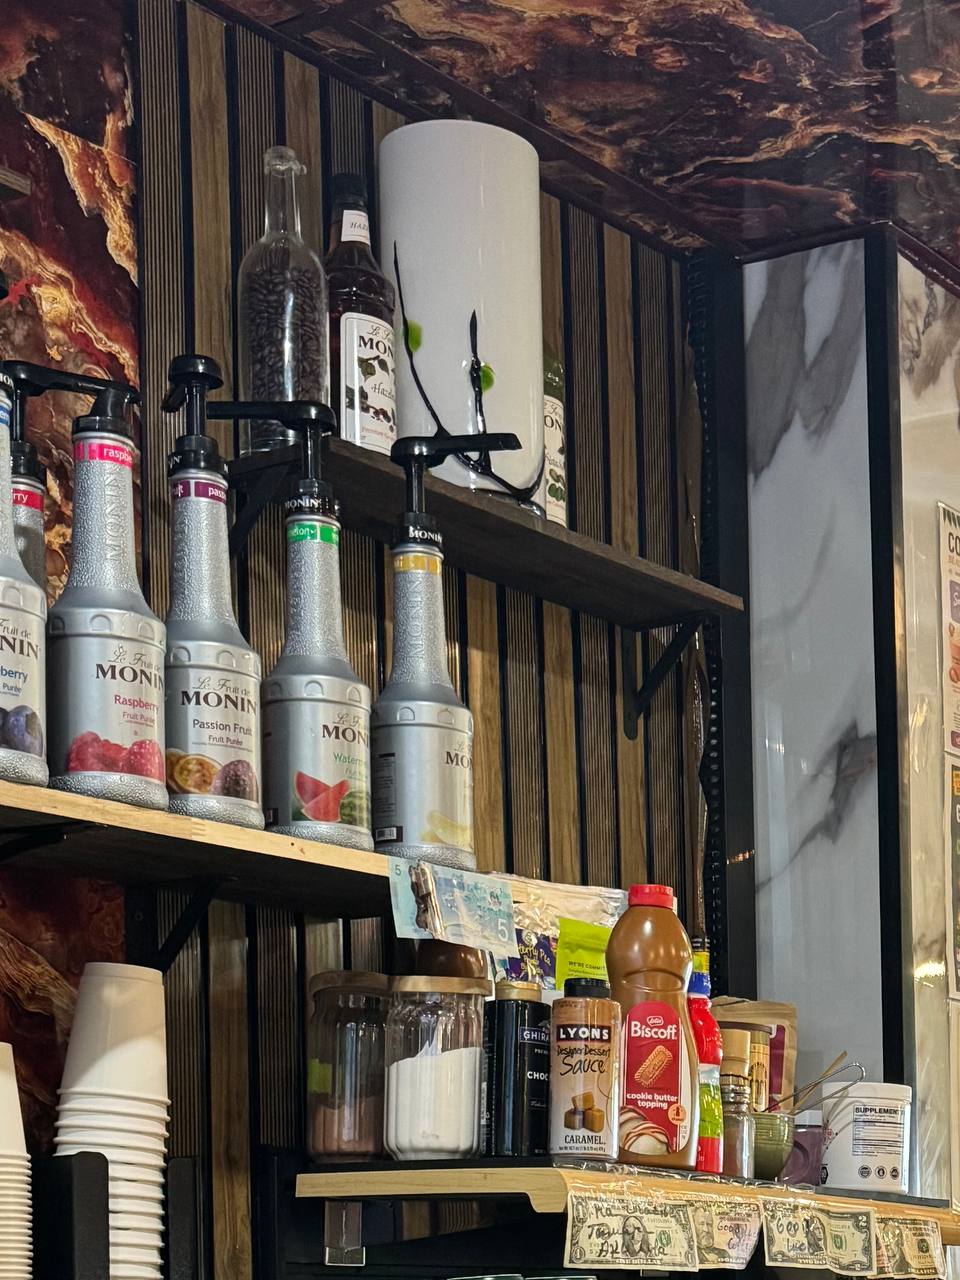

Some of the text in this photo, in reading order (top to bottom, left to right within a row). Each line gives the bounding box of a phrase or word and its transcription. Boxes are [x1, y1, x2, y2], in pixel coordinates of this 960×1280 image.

[350, 221, 369, 232] HAZ
[358, 335, 394, 359] MON
[103, 446, 132, 462] raspbe
[12, 492, 28, 503] rry
[208, 486, 226, 498] pass
[0, 635, 39, 659] NIN
[0, 665, 28, 684] berry
[95, 663, 164, 692] MONIN
[114, 694, 160, 715] Raspberry
[181, 690, 257, 716] MONIN
[192, 718, 231, 733] Passion
[208, 734, 223, 744] Fruit
[322, 723, 369, 748] MON
[333, 751, 368, 766] Waterm
[395, 866, 402, 877] 5
[497, 918, 510, 943] 5
[586, 963, 607, 971] COMMIT
[559, 1026, 610, 1041] LYONS
[630, 1021, 678, 1040] Biscoff
[556, 1044, 611, 1058] Designer Dessert
[559, 1054, 606, 1076] Sauce
[626, 1092, 678, 1102] cookie butter
[637, 1099, 669, 1110] topping
[564, 1134, 604, 1145] CARAMEL
[858, 1215, 867, 1227] 2
